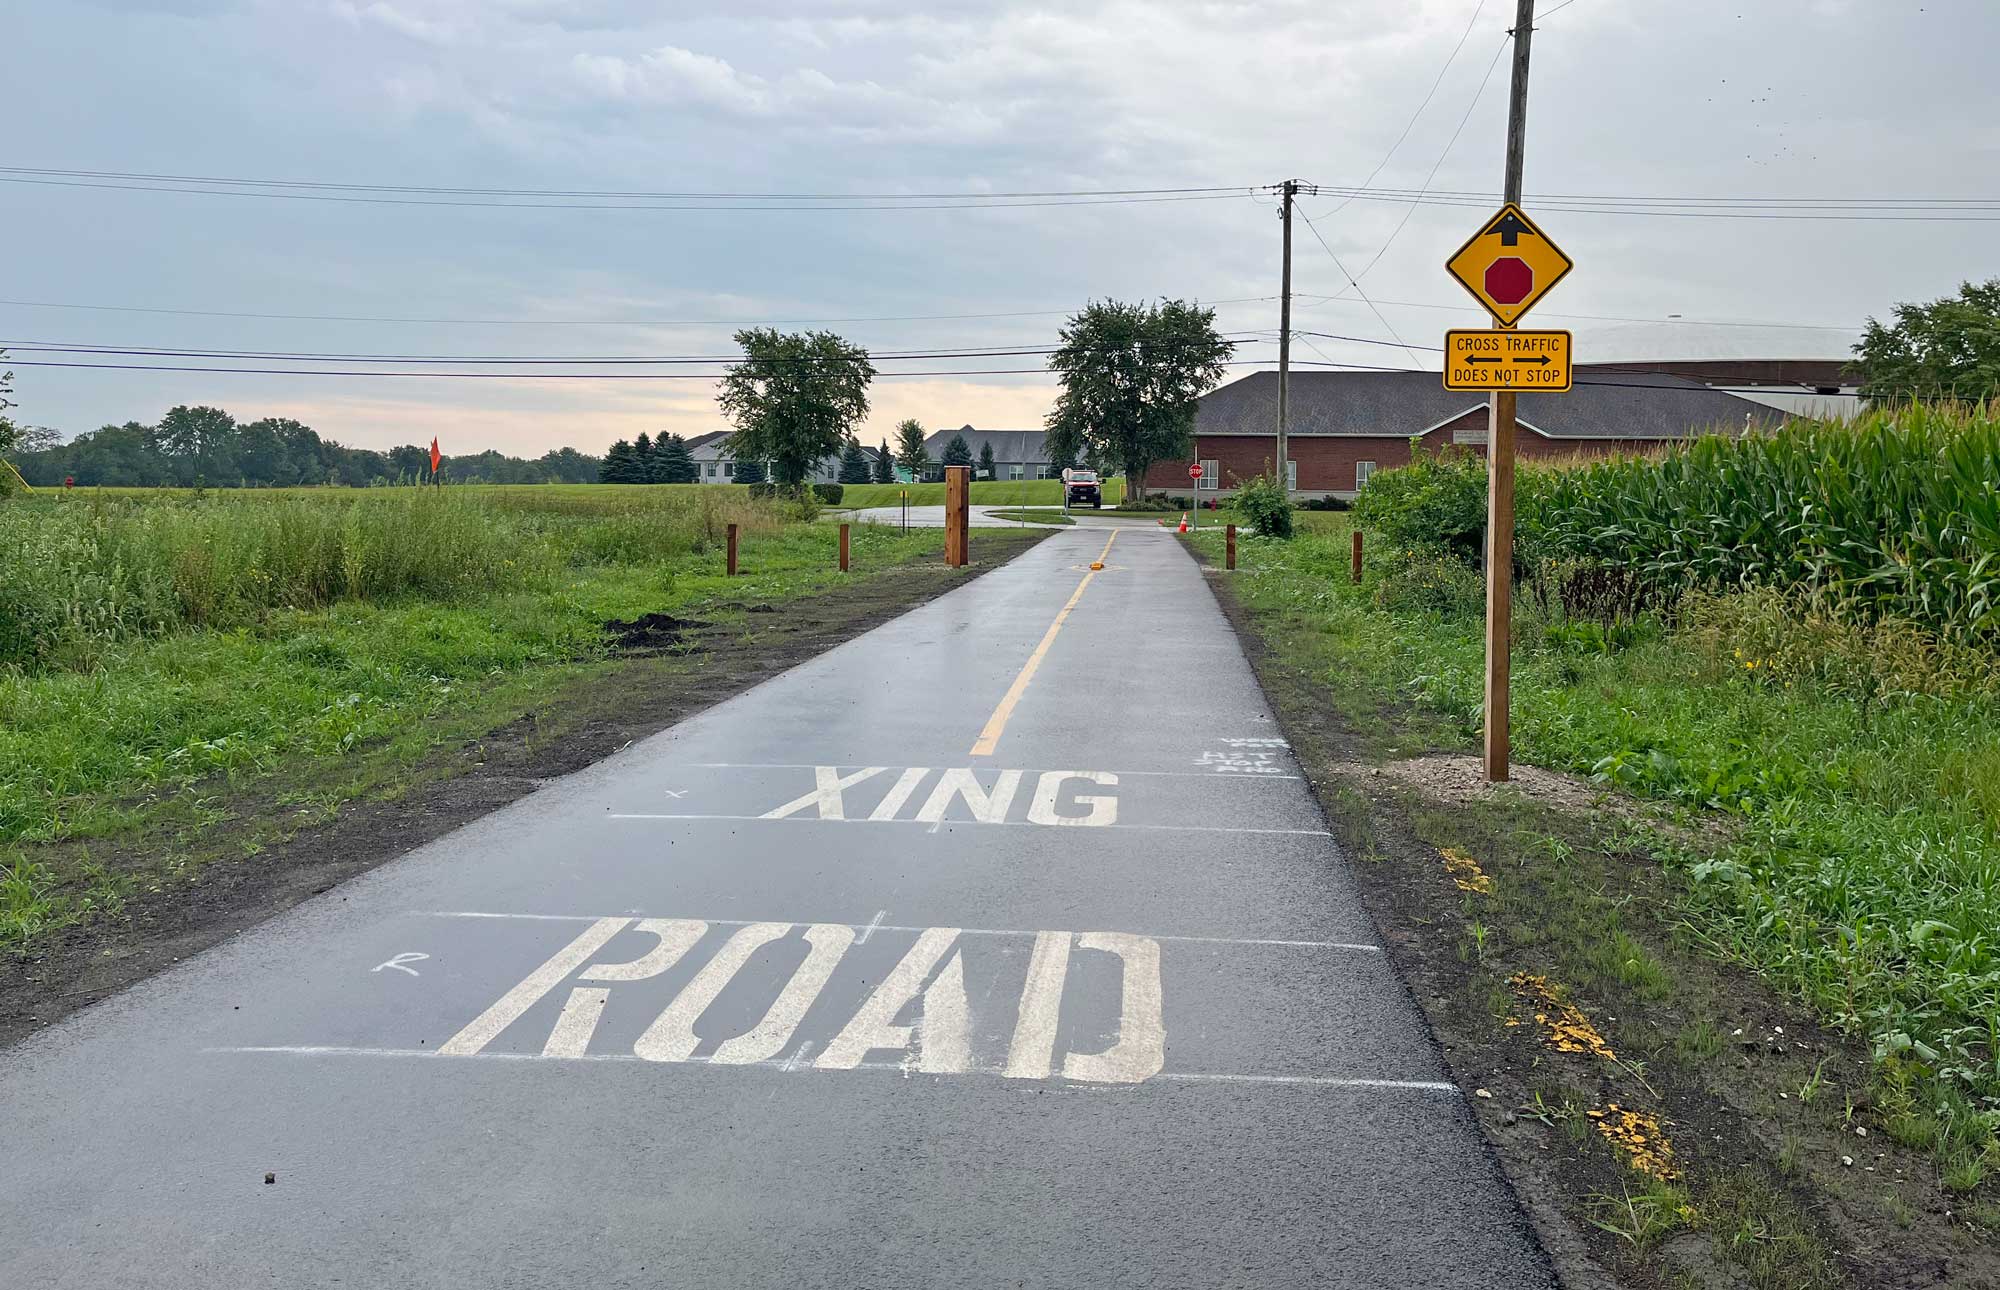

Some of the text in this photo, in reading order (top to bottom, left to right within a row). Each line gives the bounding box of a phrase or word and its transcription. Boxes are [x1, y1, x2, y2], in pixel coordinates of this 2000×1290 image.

[1457, 338, 1560, 351] CROSS TRAFFIC
[1455, 369, 1560, 382] DOES NOT STOP
[757, 767, 1119, 826] XING
[436, 916, 1165, 1083] ROAD
